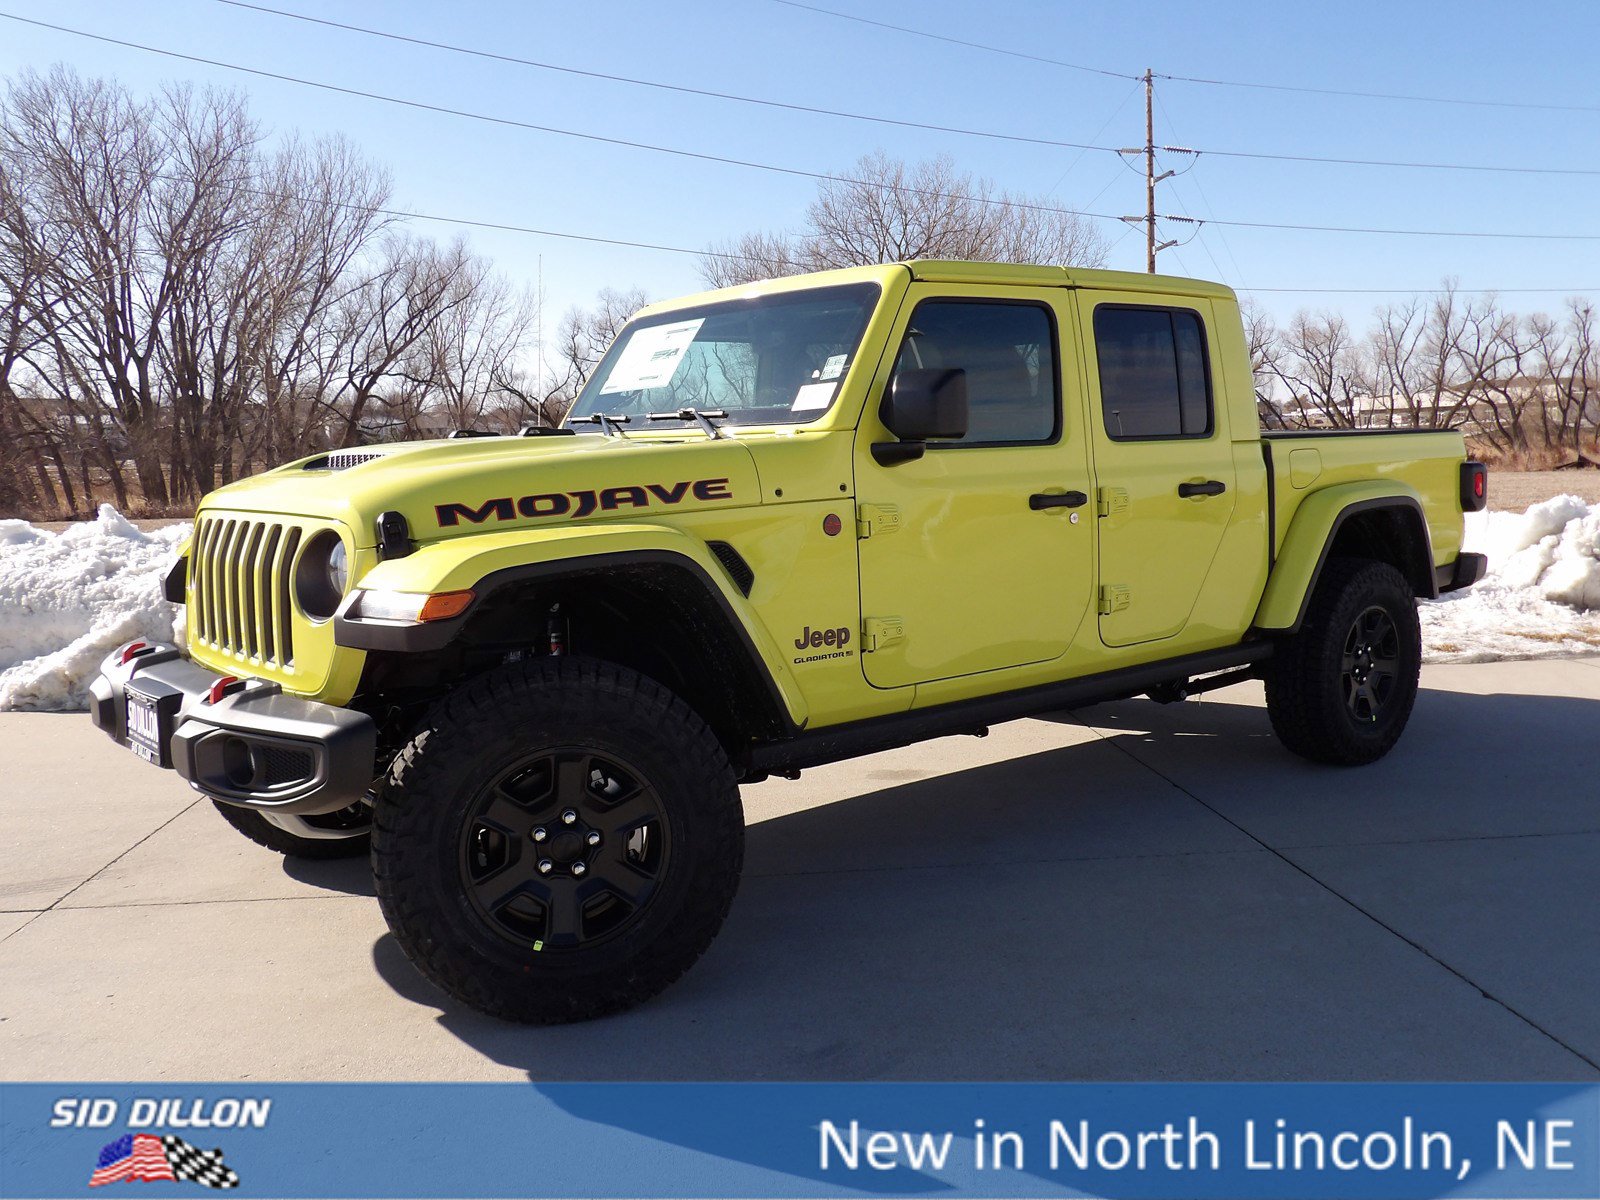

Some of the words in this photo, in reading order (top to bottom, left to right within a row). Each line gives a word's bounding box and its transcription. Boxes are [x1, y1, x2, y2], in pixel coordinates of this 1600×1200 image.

[434, 477, 733, 527] MOJAVE
[795, 626, 850, 649] Jeep
[794, 652, 844, 664] GLADIATOR
